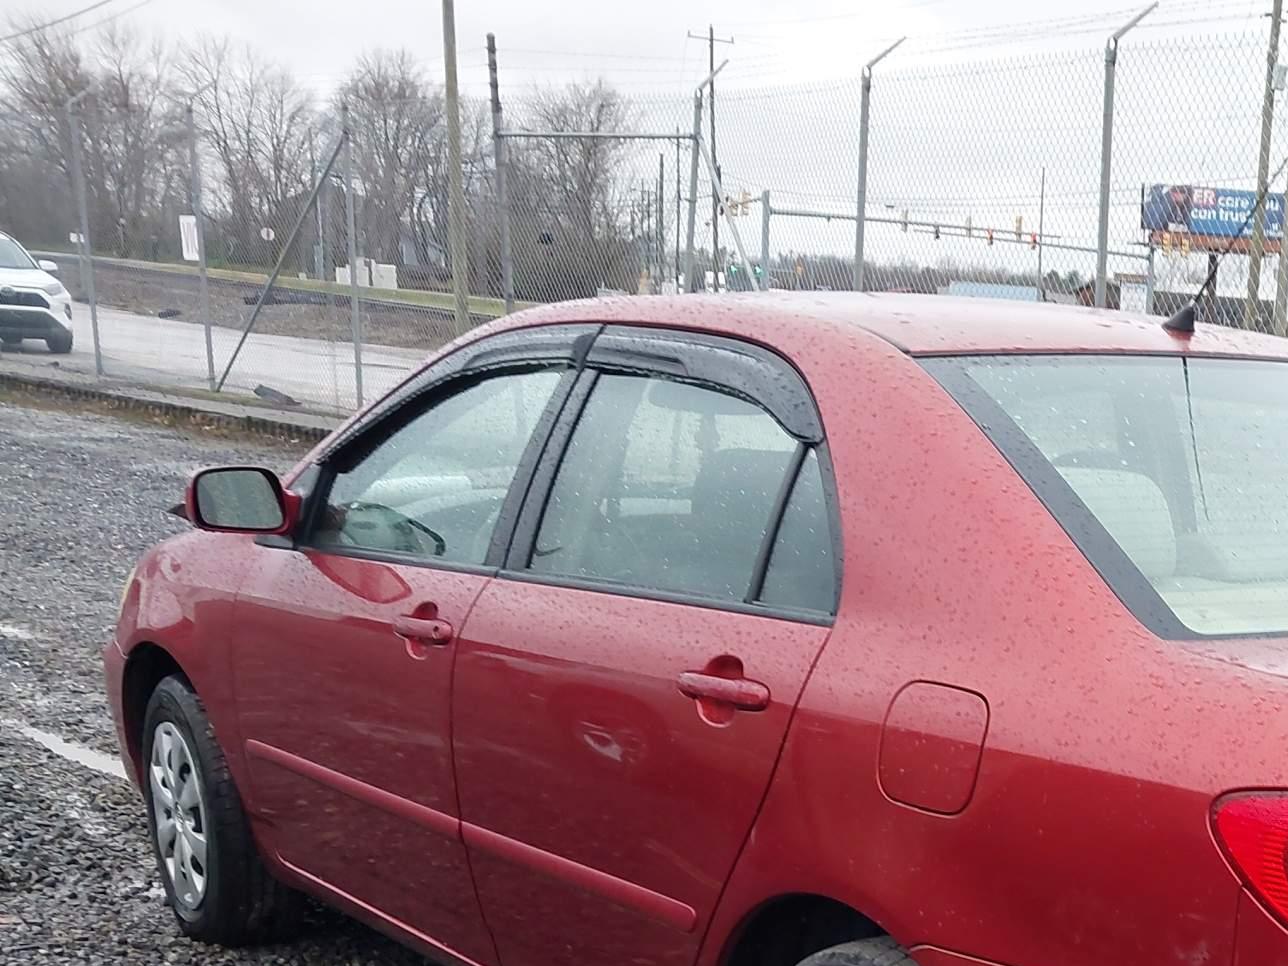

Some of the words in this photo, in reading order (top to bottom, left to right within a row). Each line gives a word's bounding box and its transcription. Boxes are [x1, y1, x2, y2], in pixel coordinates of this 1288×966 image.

[1193, 189, 1216, 206] ER
[1218, 196, 1249, 210] care
[1191, 208, 1216, 220] can
